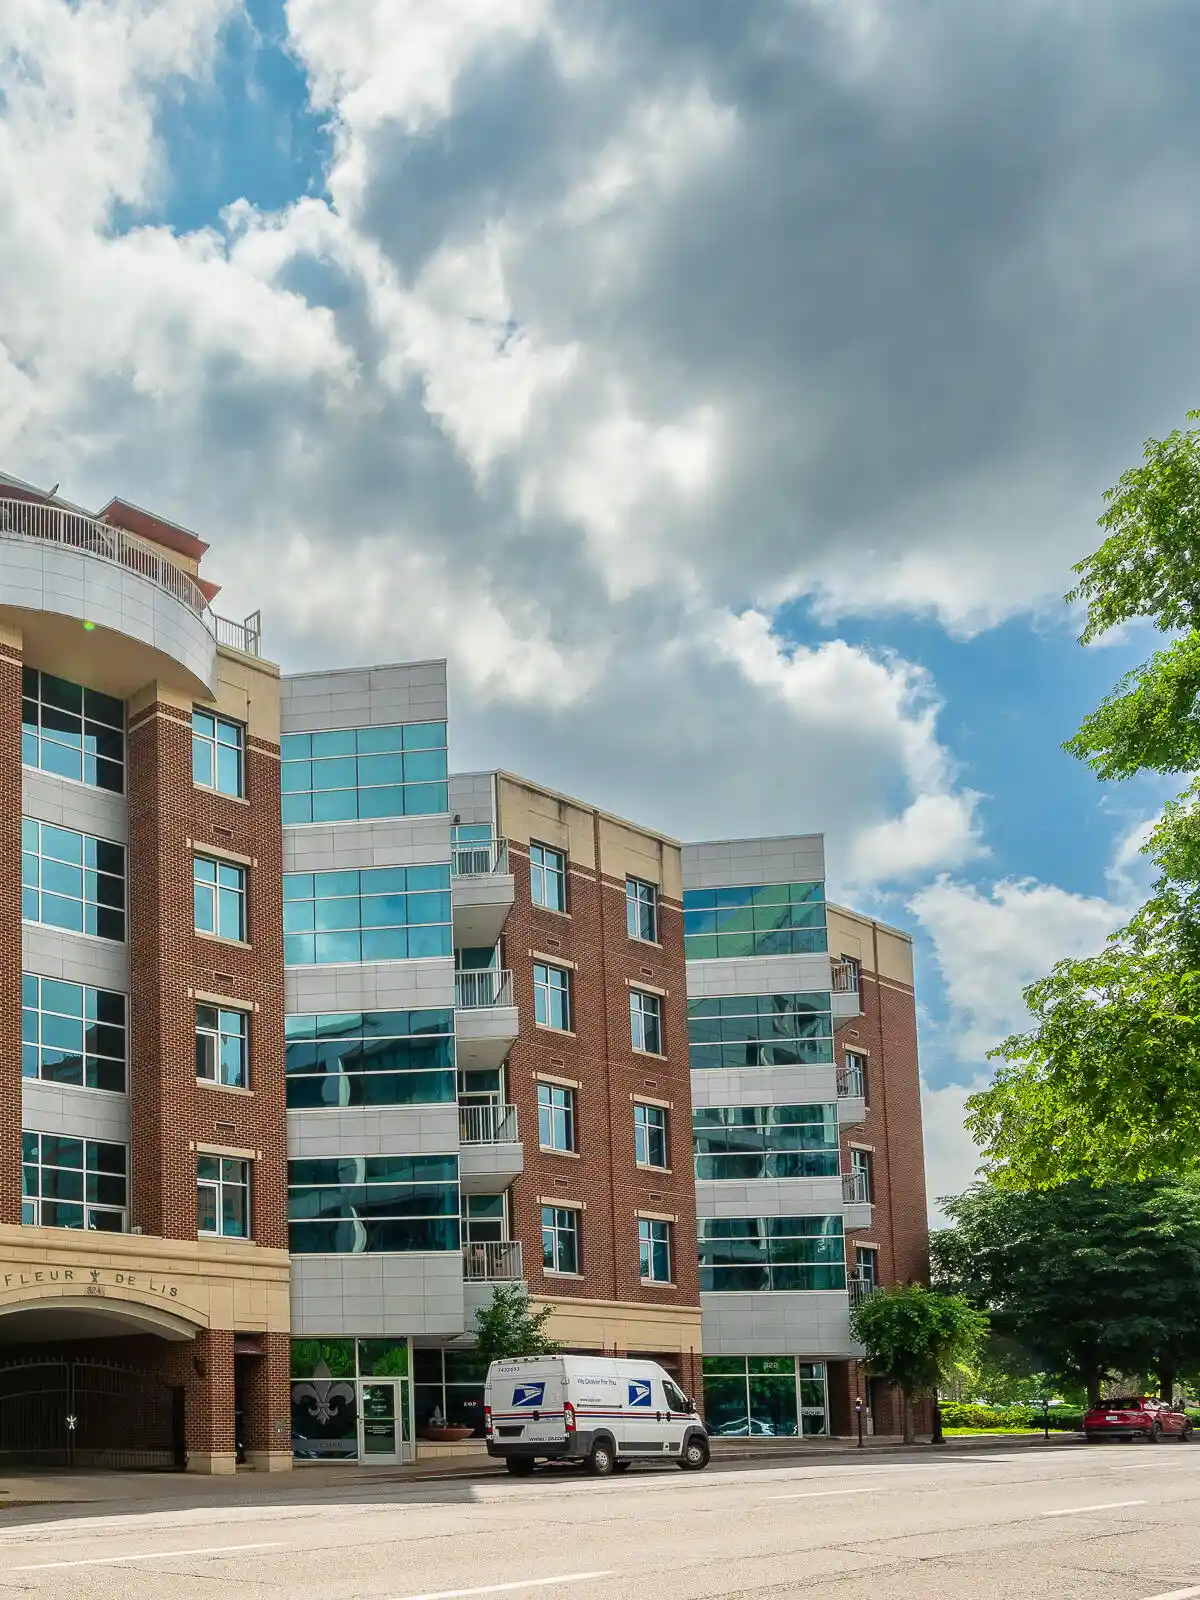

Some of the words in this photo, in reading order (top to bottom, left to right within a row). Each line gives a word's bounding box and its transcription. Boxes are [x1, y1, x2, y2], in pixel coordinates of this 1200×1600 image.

[3, 1270, 75, 1287] FLEUR
[115, 1273, 136, 1286] DE
[149, 1278, 179, 1298] LIS
